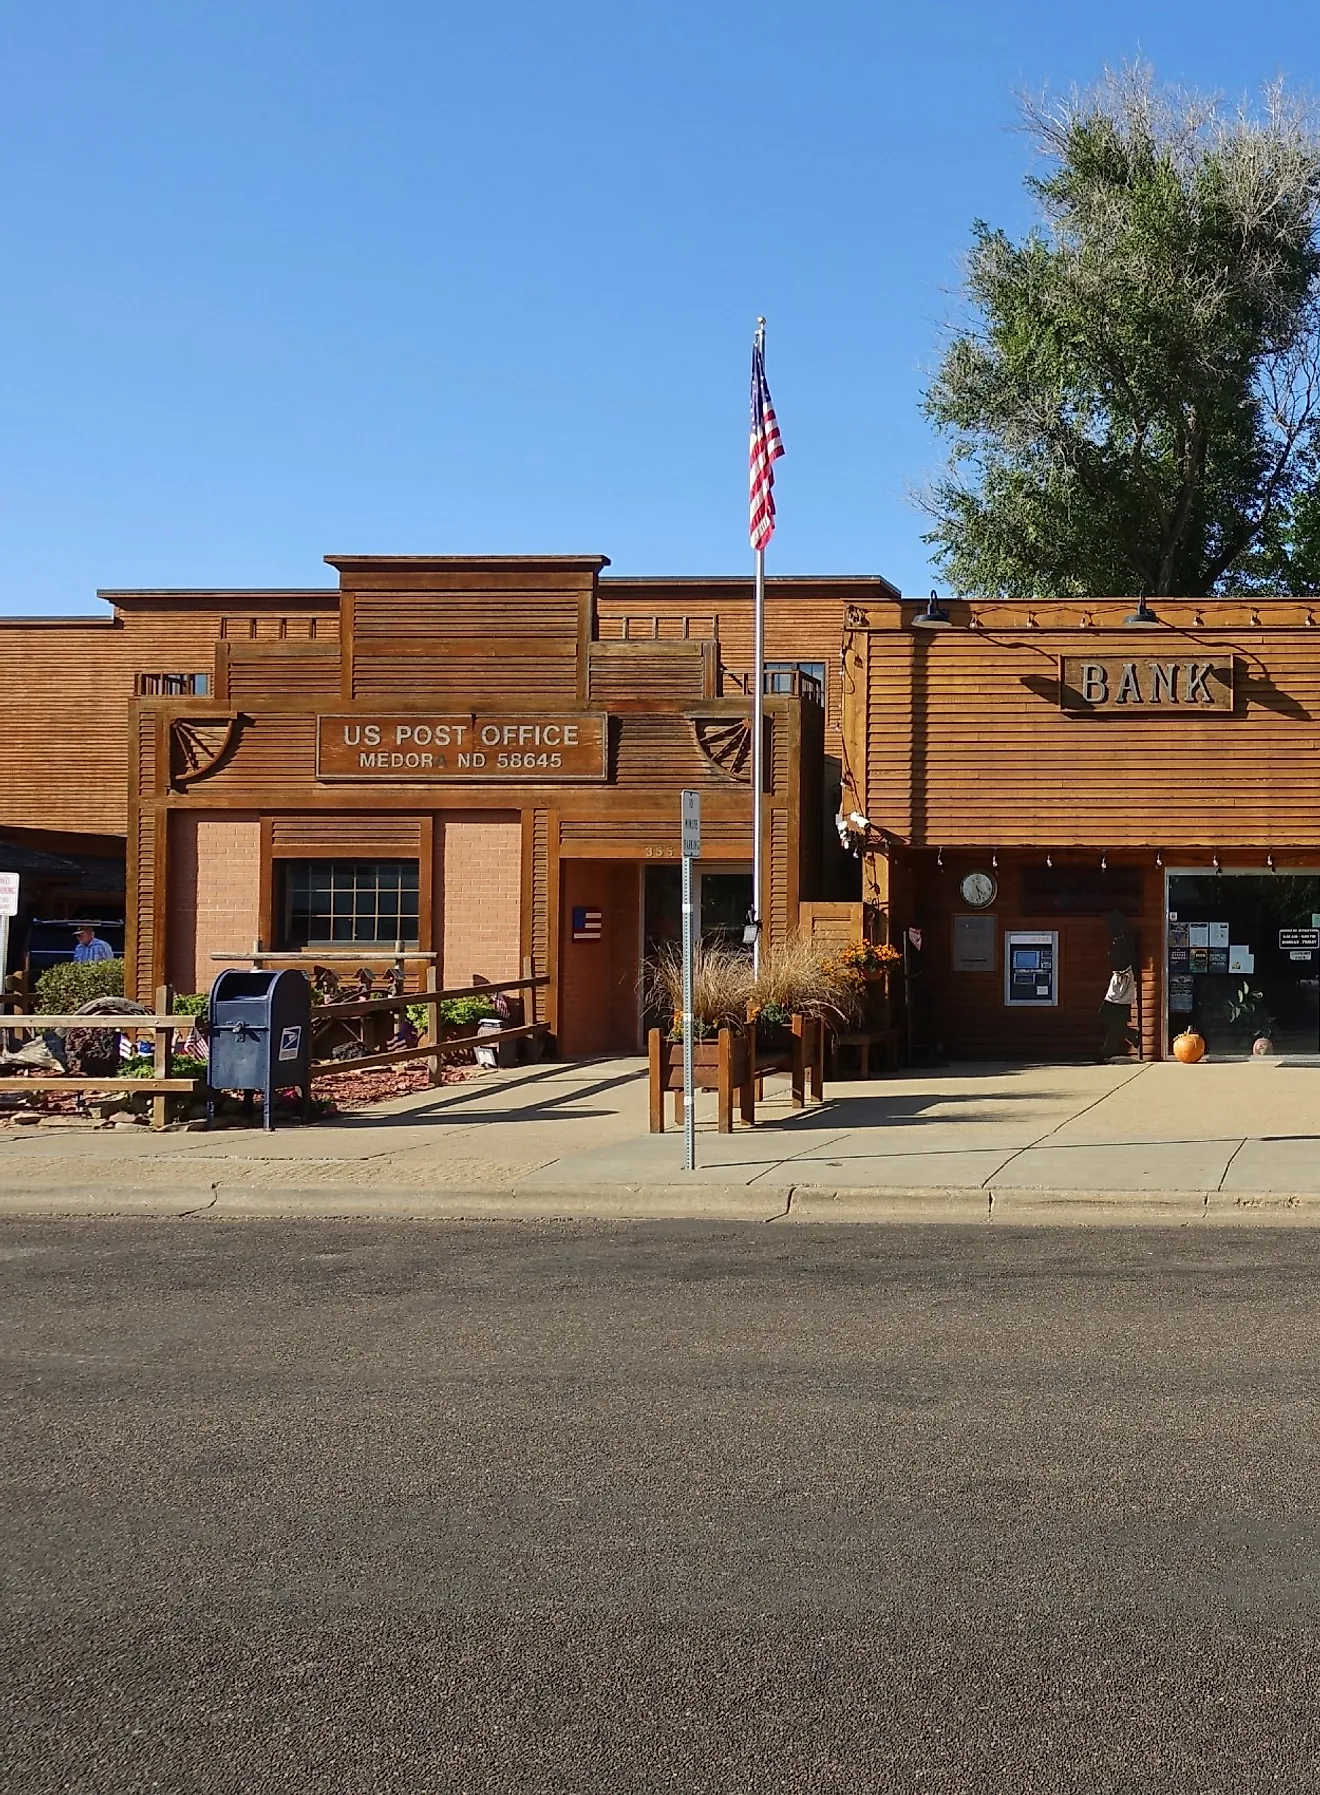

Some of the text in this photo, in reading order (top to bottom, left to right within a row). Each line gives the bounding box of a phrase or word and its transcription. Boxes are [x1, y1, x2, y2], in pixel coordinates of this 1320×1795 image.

[1081, 663, 1215, 704] BANK
[343, 725, 579, 746] US POST OFFICE
[457, 753, 486, 768] ND
[496, 753, 562, 768] 58645
